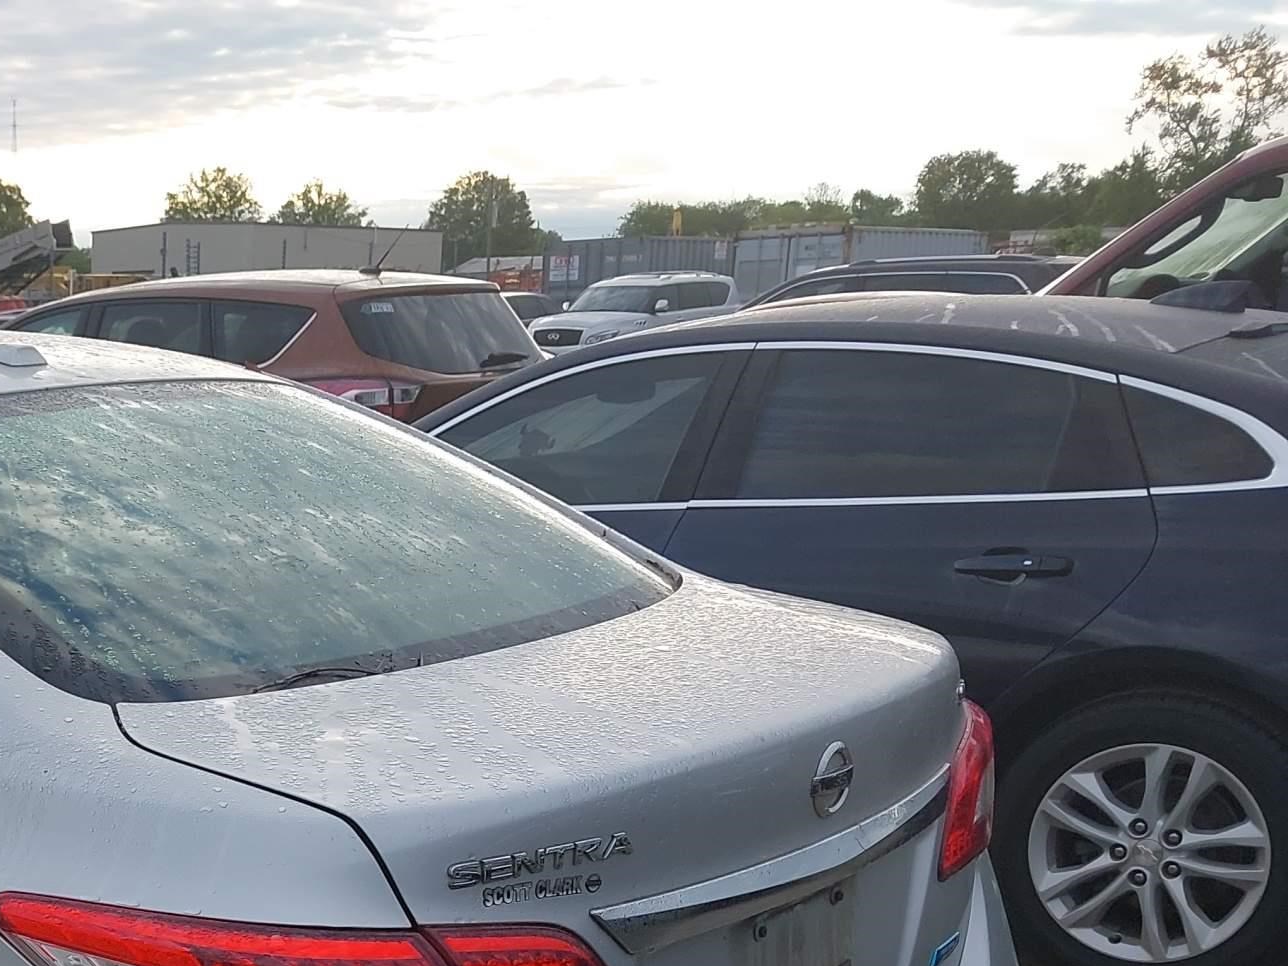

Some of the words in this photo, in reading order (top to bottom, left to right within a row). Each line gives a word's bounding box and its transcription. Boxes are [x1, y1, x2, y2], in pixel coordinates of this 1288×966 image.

[447, 831, 632, 890] SENTRA
[482, 881, 532, 907] SCOTT
[534, 875, 584, 900] CLARK
